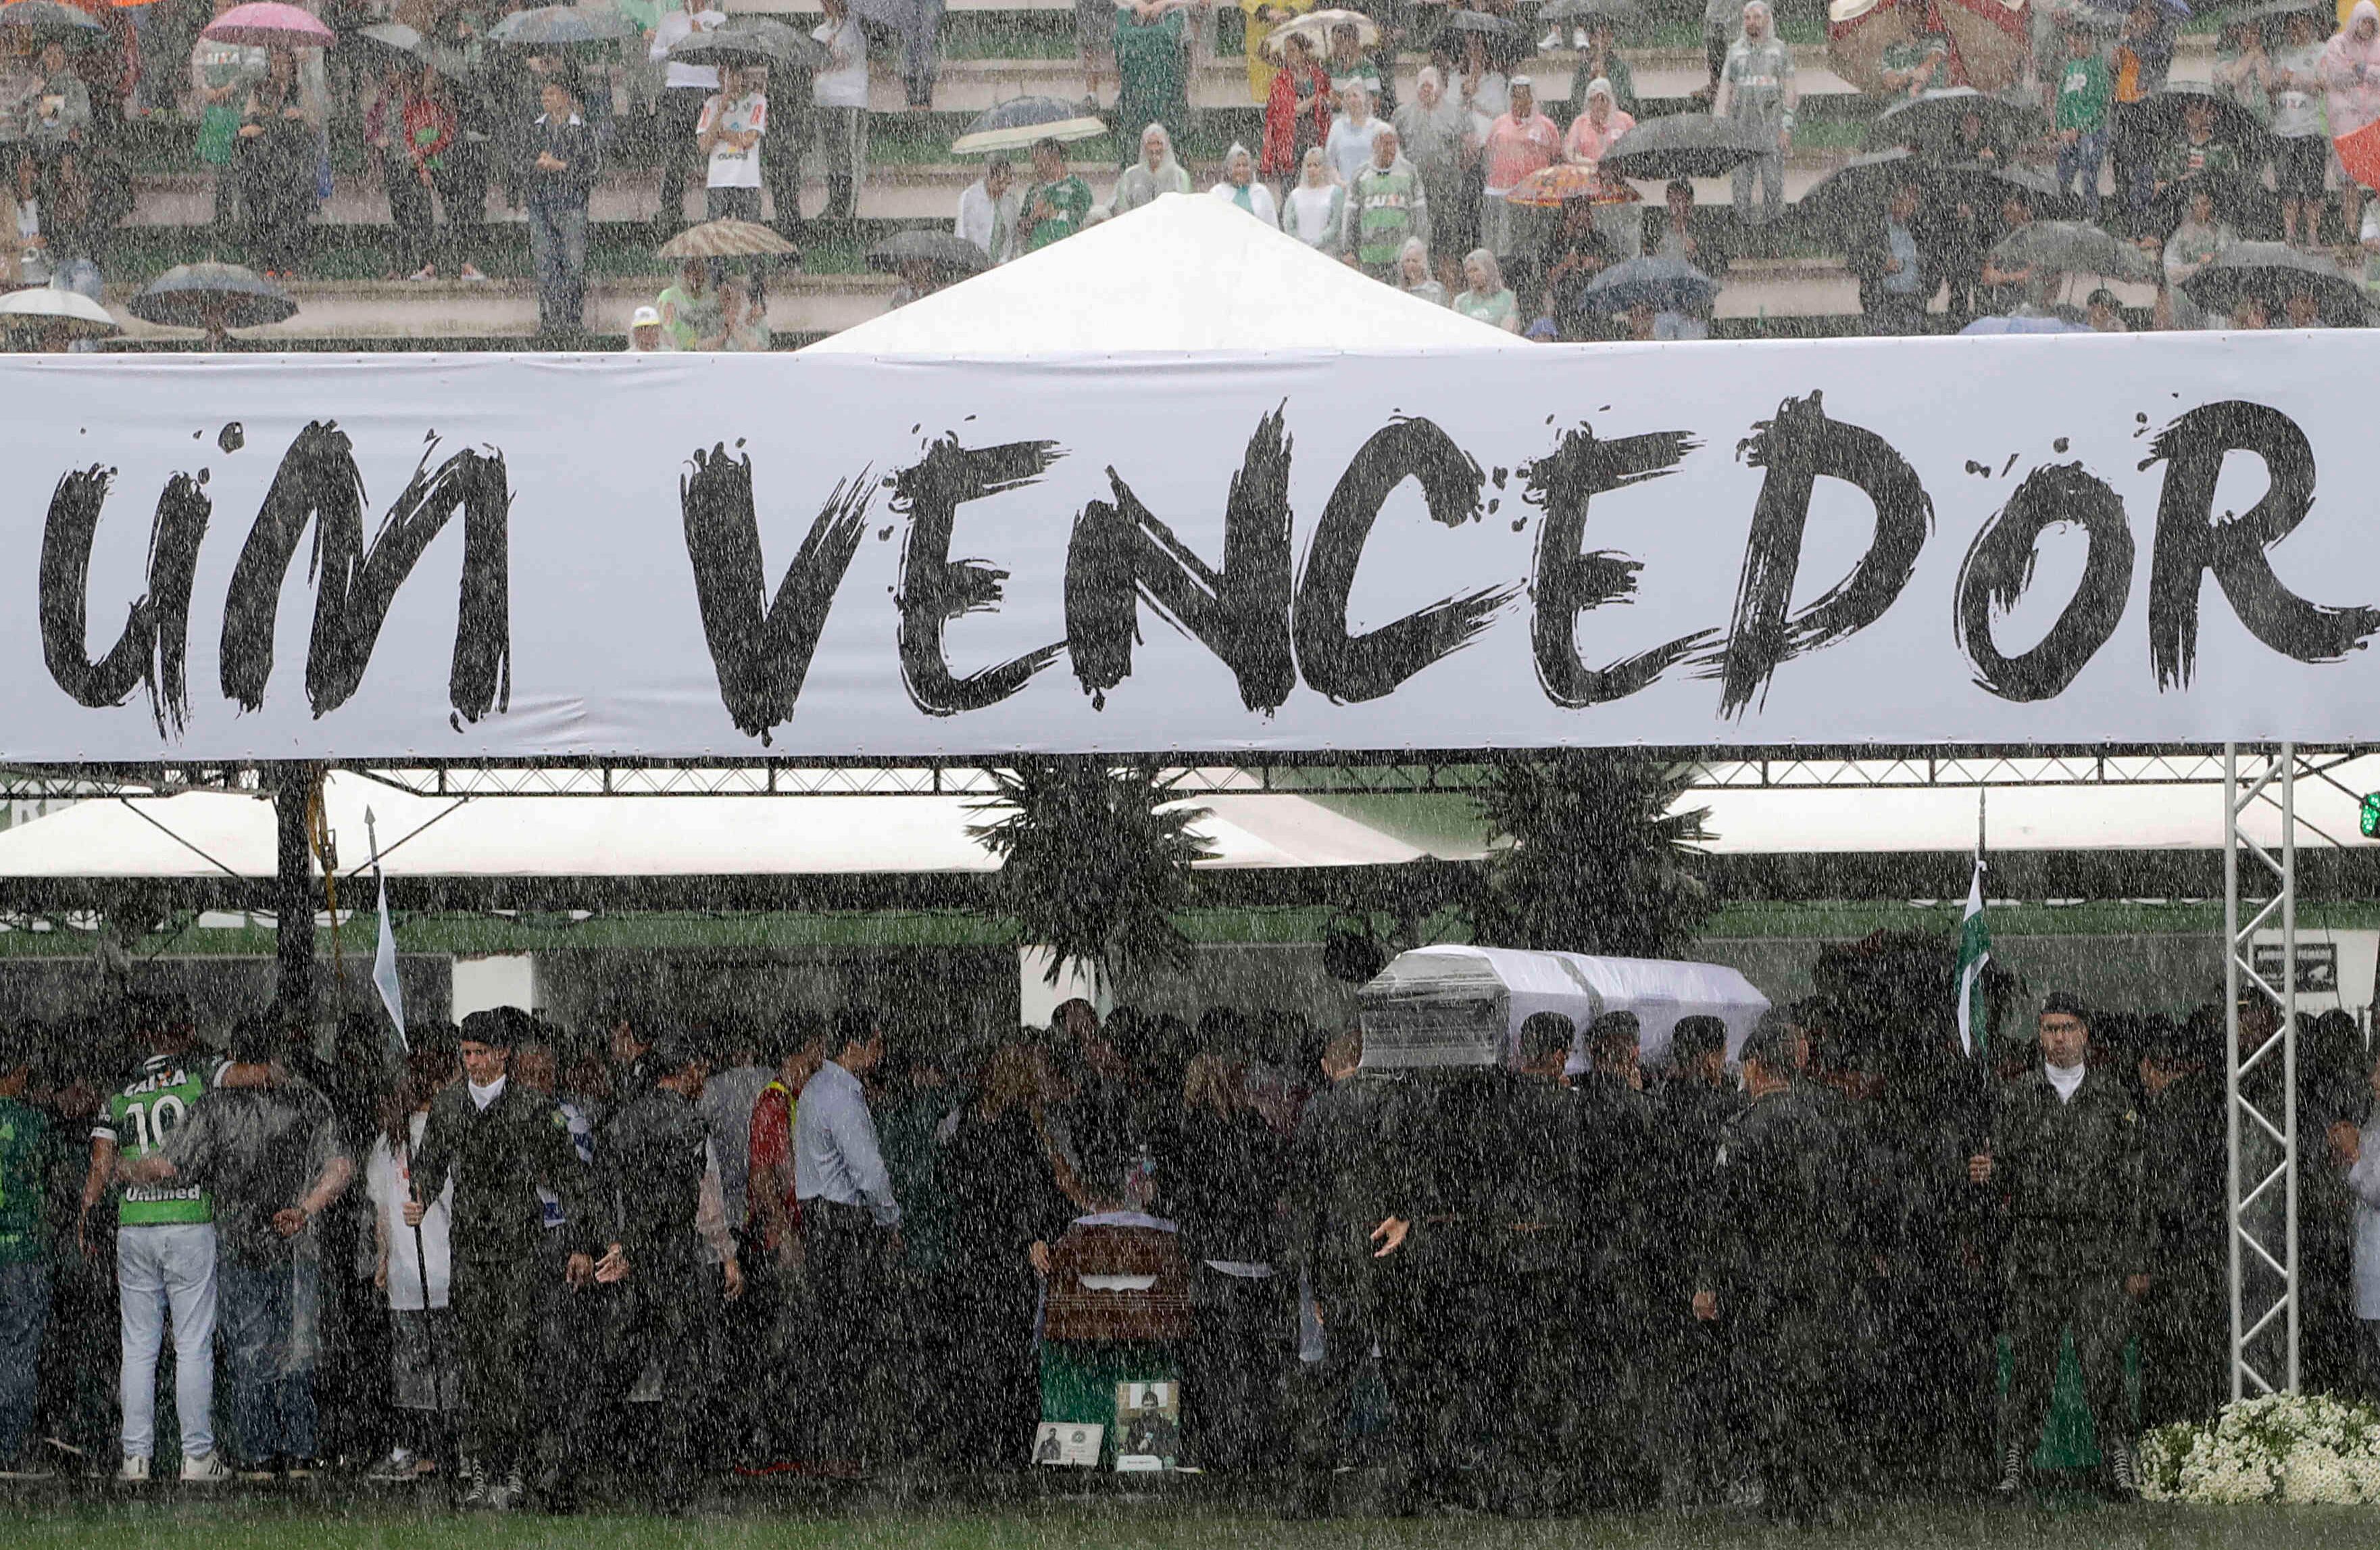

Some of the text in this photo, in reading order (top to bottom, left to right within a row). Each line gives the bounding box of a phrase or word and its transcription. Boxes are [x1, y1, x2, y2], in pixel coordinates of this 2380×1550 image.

[39, 391, 2380, 747] UM VENCEDOR
[125, 1094, 186, 1155] 10
